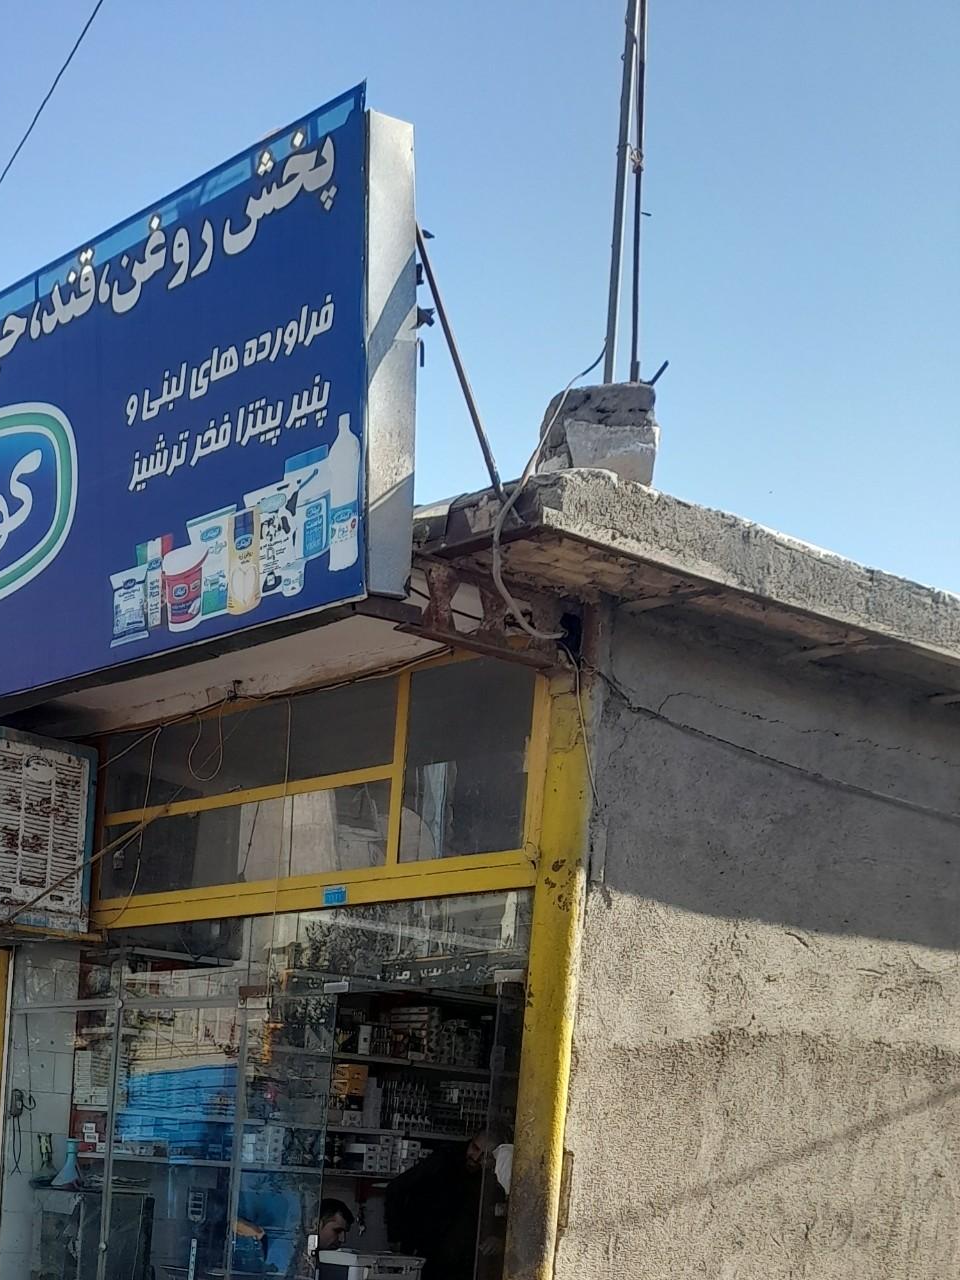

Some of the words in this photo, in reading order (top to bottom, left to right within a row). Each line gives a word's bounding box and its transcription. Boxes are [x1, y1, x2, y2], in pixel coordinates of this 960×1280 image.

[222, 130, 337, 255] پخش
[244, 295, 334, 371] فراورده
[142, 361, 187, 424] لبنی
[189, 342, 238, 400] های
[125, 394, 137, 426] و
[235, 397, 282, 449] پیتزا
[286, 374, 330, 434] پنیر
[188, 417, 231, 466] فخر
